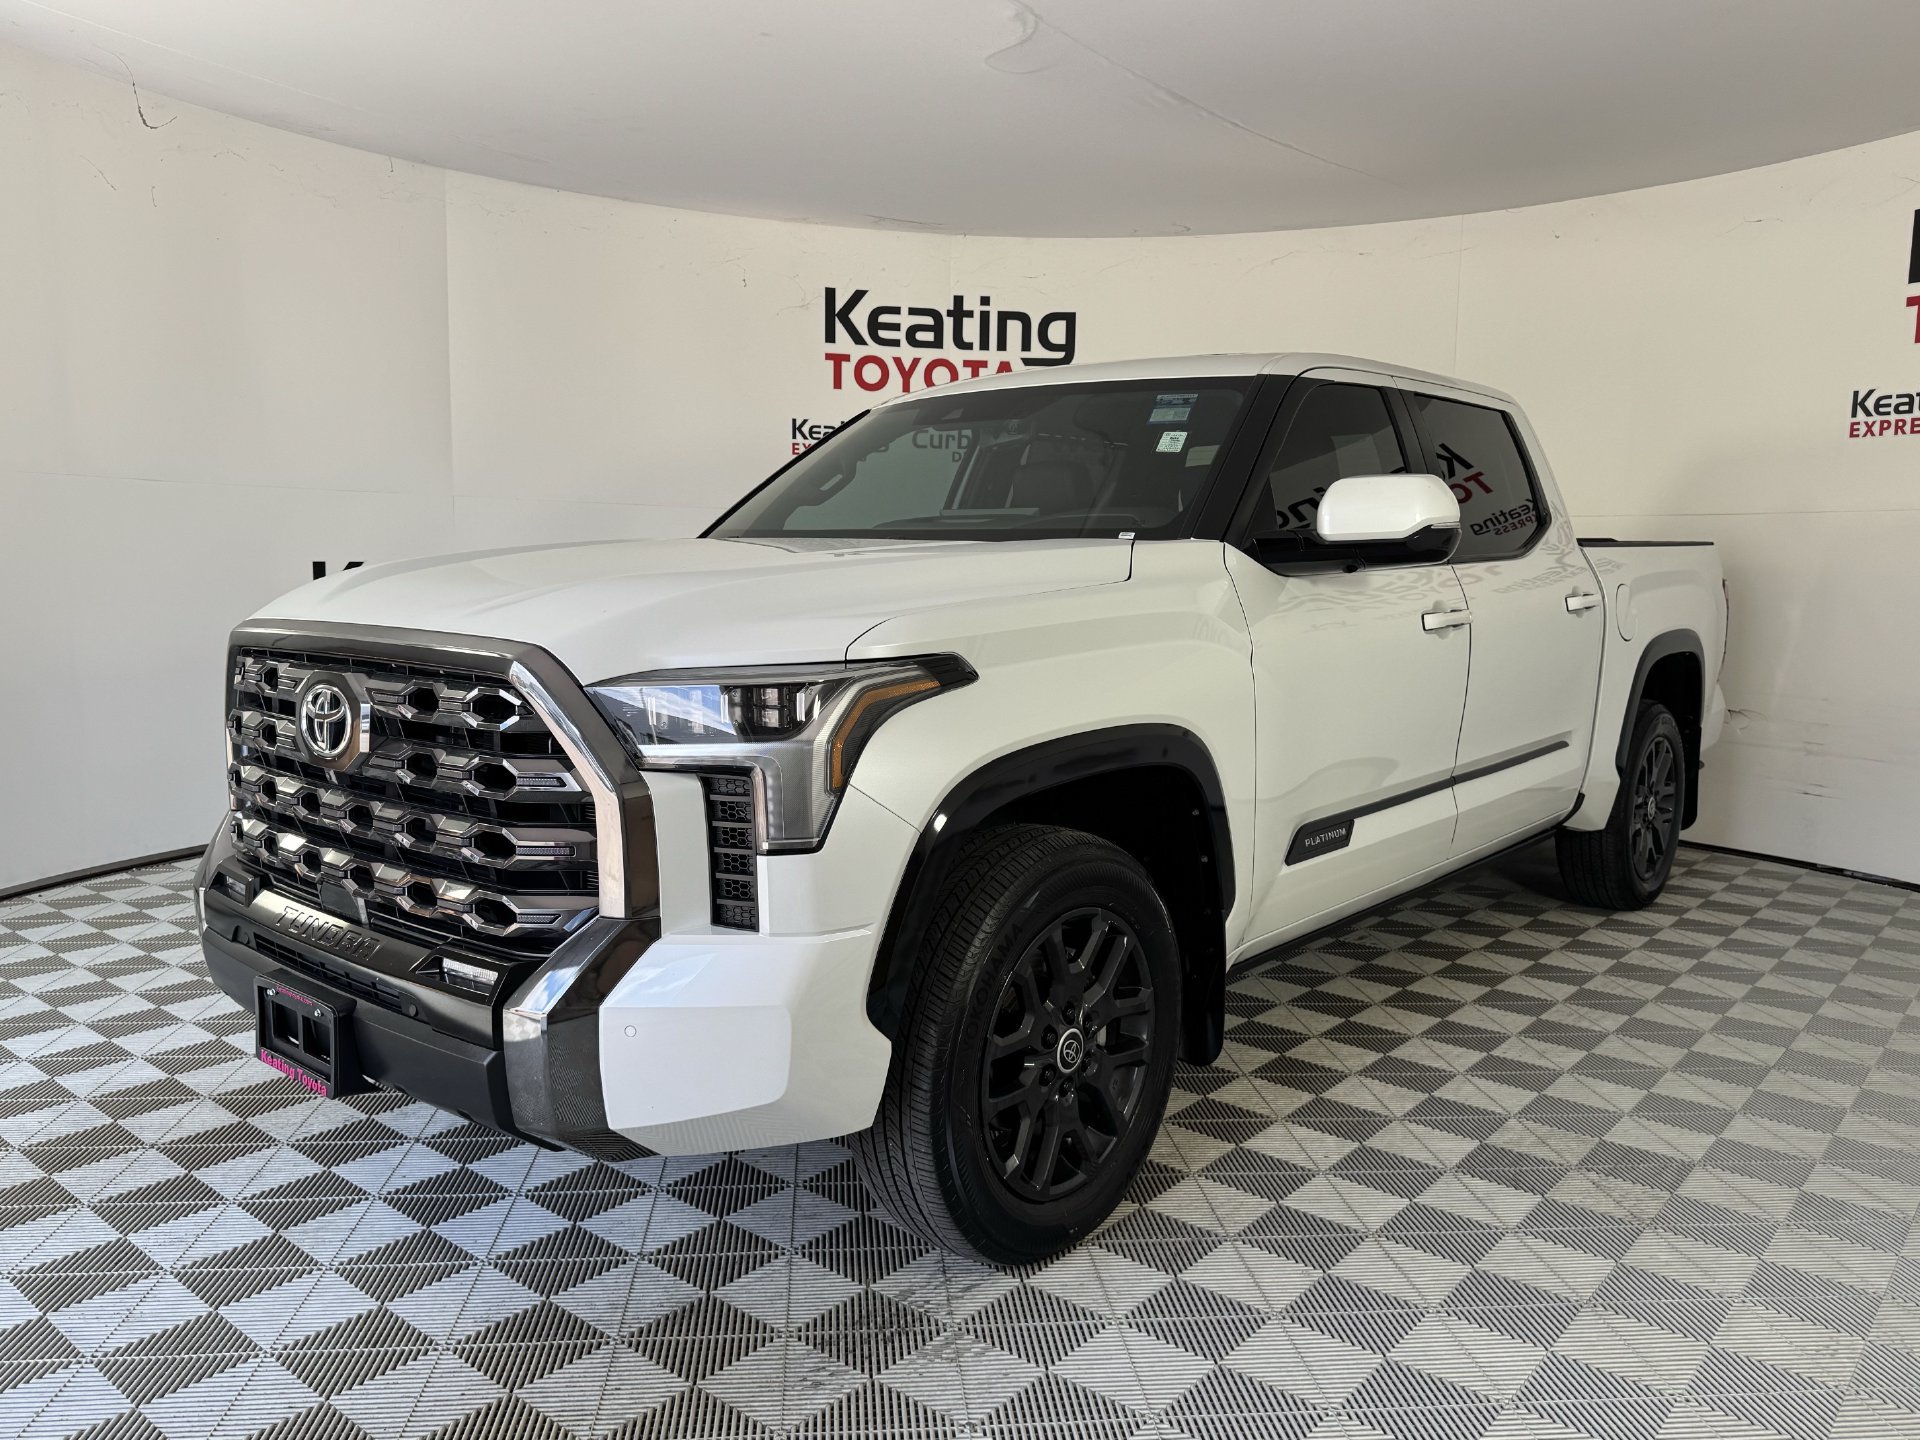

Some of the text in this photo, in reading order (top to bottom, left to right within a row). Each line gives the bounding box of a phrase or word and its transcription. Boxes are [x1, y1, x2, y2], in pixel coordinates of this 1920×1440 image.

[825, 287, 1076, 366] Keating
[1305, 828, 1346, 847] PLATINUM
[275, 905, 381, 961] TUNDRA
[261, 1049, 327, 1098] Keating Toyota
